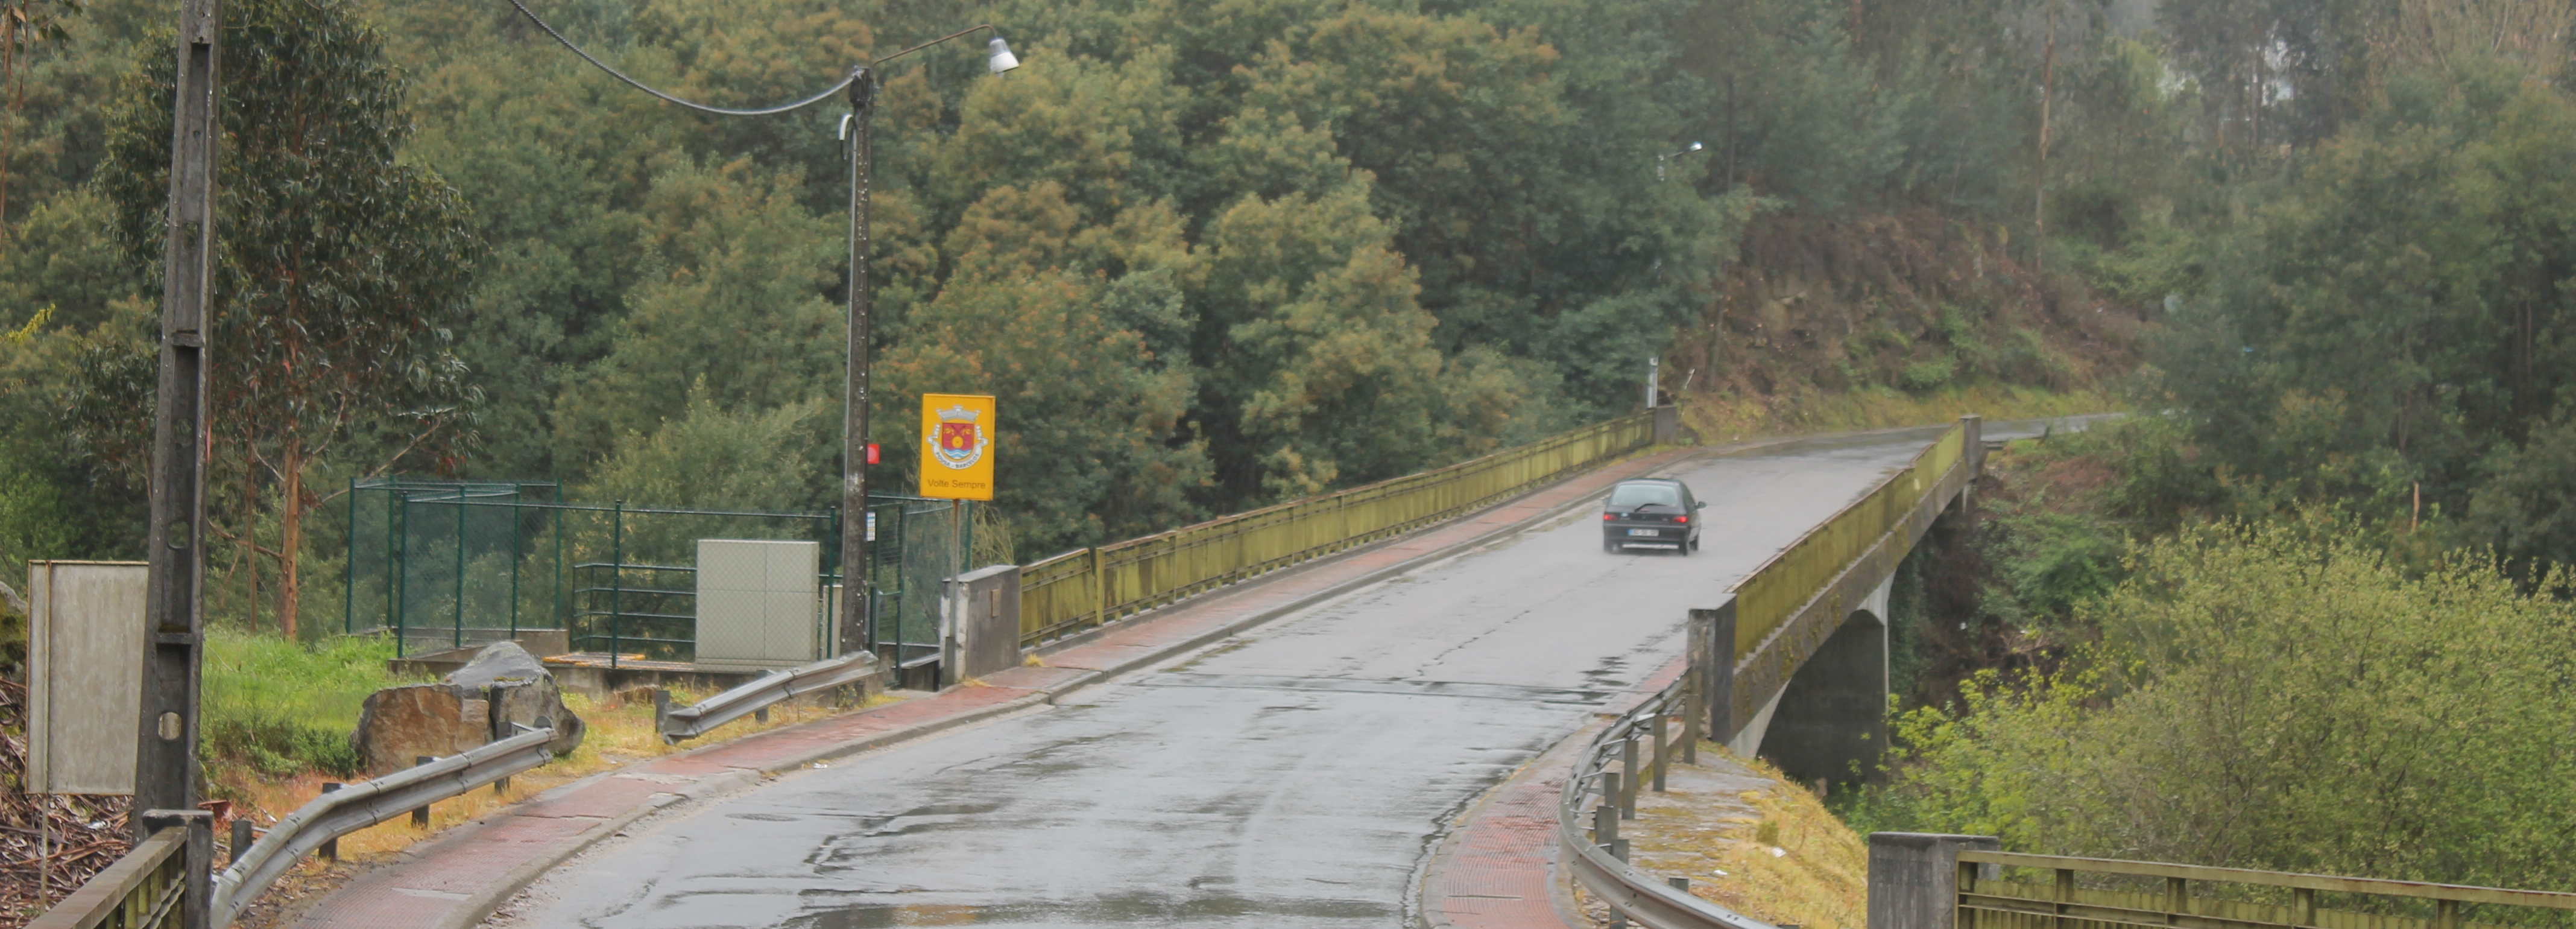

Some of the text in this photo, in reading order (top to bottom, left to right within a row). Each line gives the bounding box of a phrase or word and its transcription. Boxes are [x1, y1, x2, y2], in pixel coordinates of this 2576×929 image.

[936, 452, 979, 468] POUSA BARCELOS
[927, 479, 986, 490] Volte Sempre
